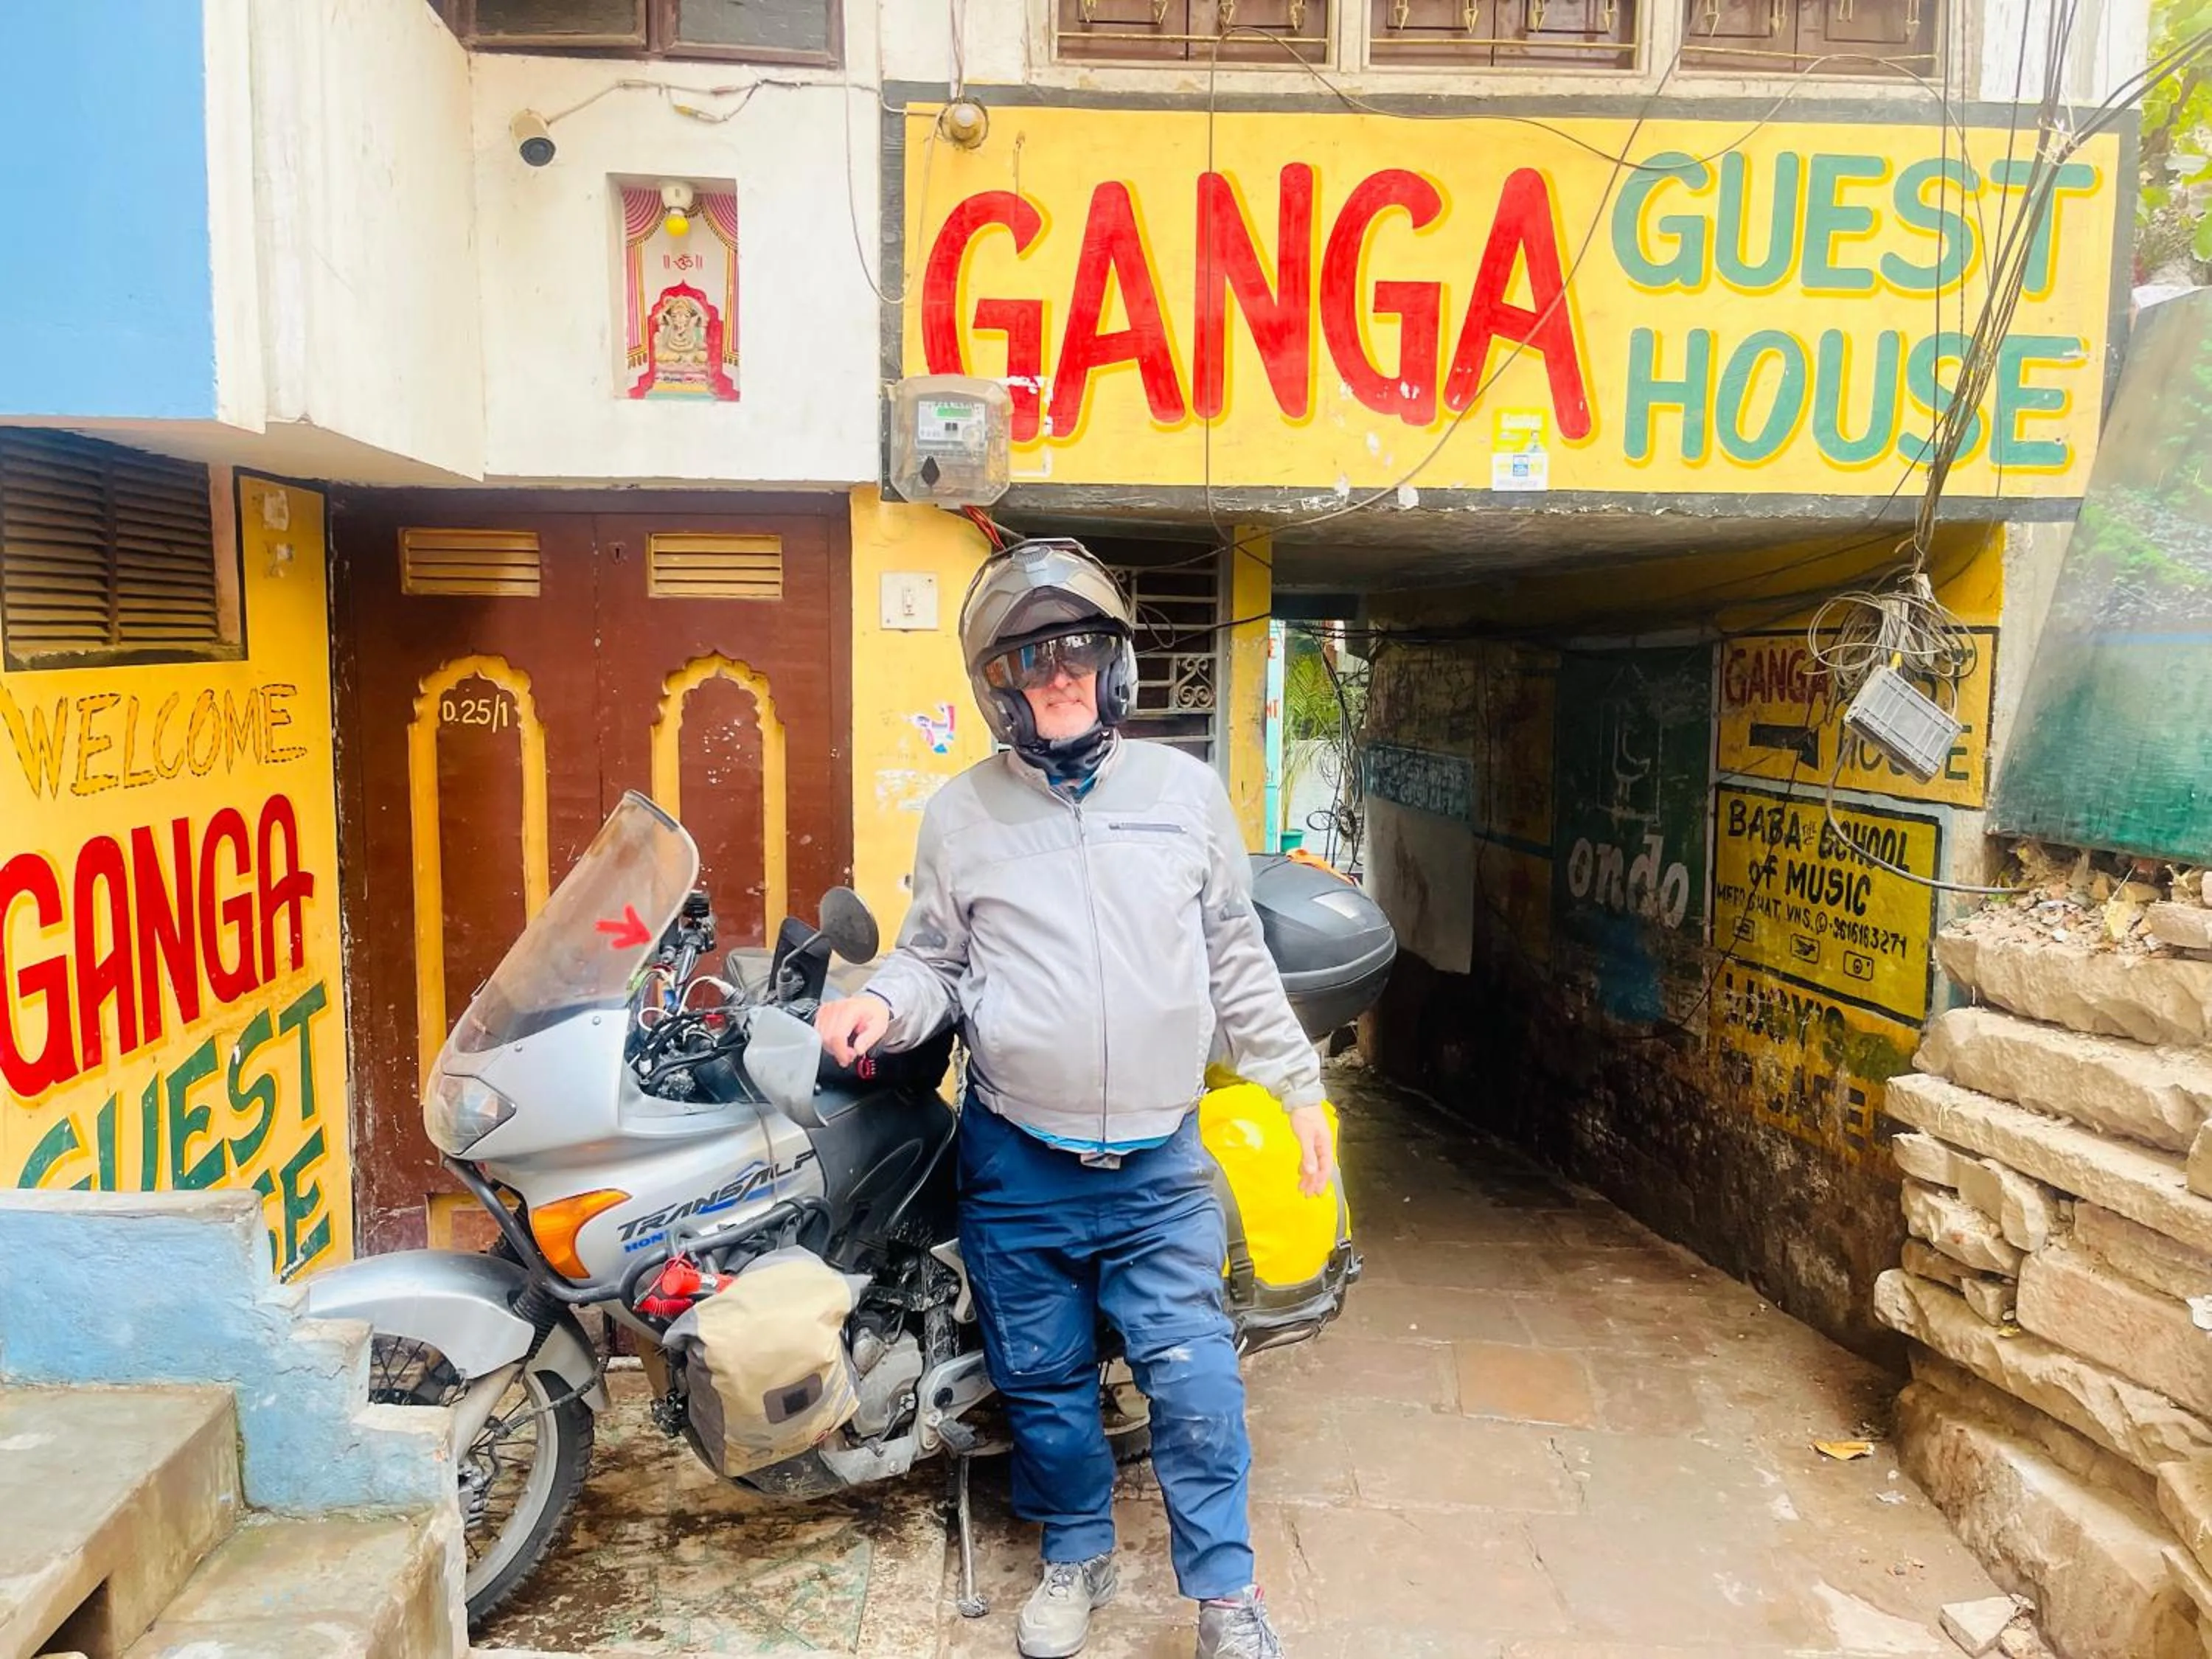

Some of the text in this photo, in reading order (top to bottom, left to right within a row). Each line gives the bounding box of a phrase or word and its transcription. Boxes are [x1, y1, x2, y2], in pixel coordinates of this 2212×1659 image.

[922, 150, 2096, 444] GANGA GUEST
[1623, 327, 2087, 467] HOUSE
[442, 694, 509, 734] D.25/1
[1722, 647, 1830, 705] GANGA
[0, 681, 307, 801] WELCOME
[1728, 799, 1801, 852] BABA
[1818, 818, 1910, 874] SCHOOL
[1784, 858, 1872, 917] MUSIC
[0, 793, 314, 1097] GANGA
[617, 1148, 815, 1242] TRANSALP
[624, 1230, 671, 1253] HON
